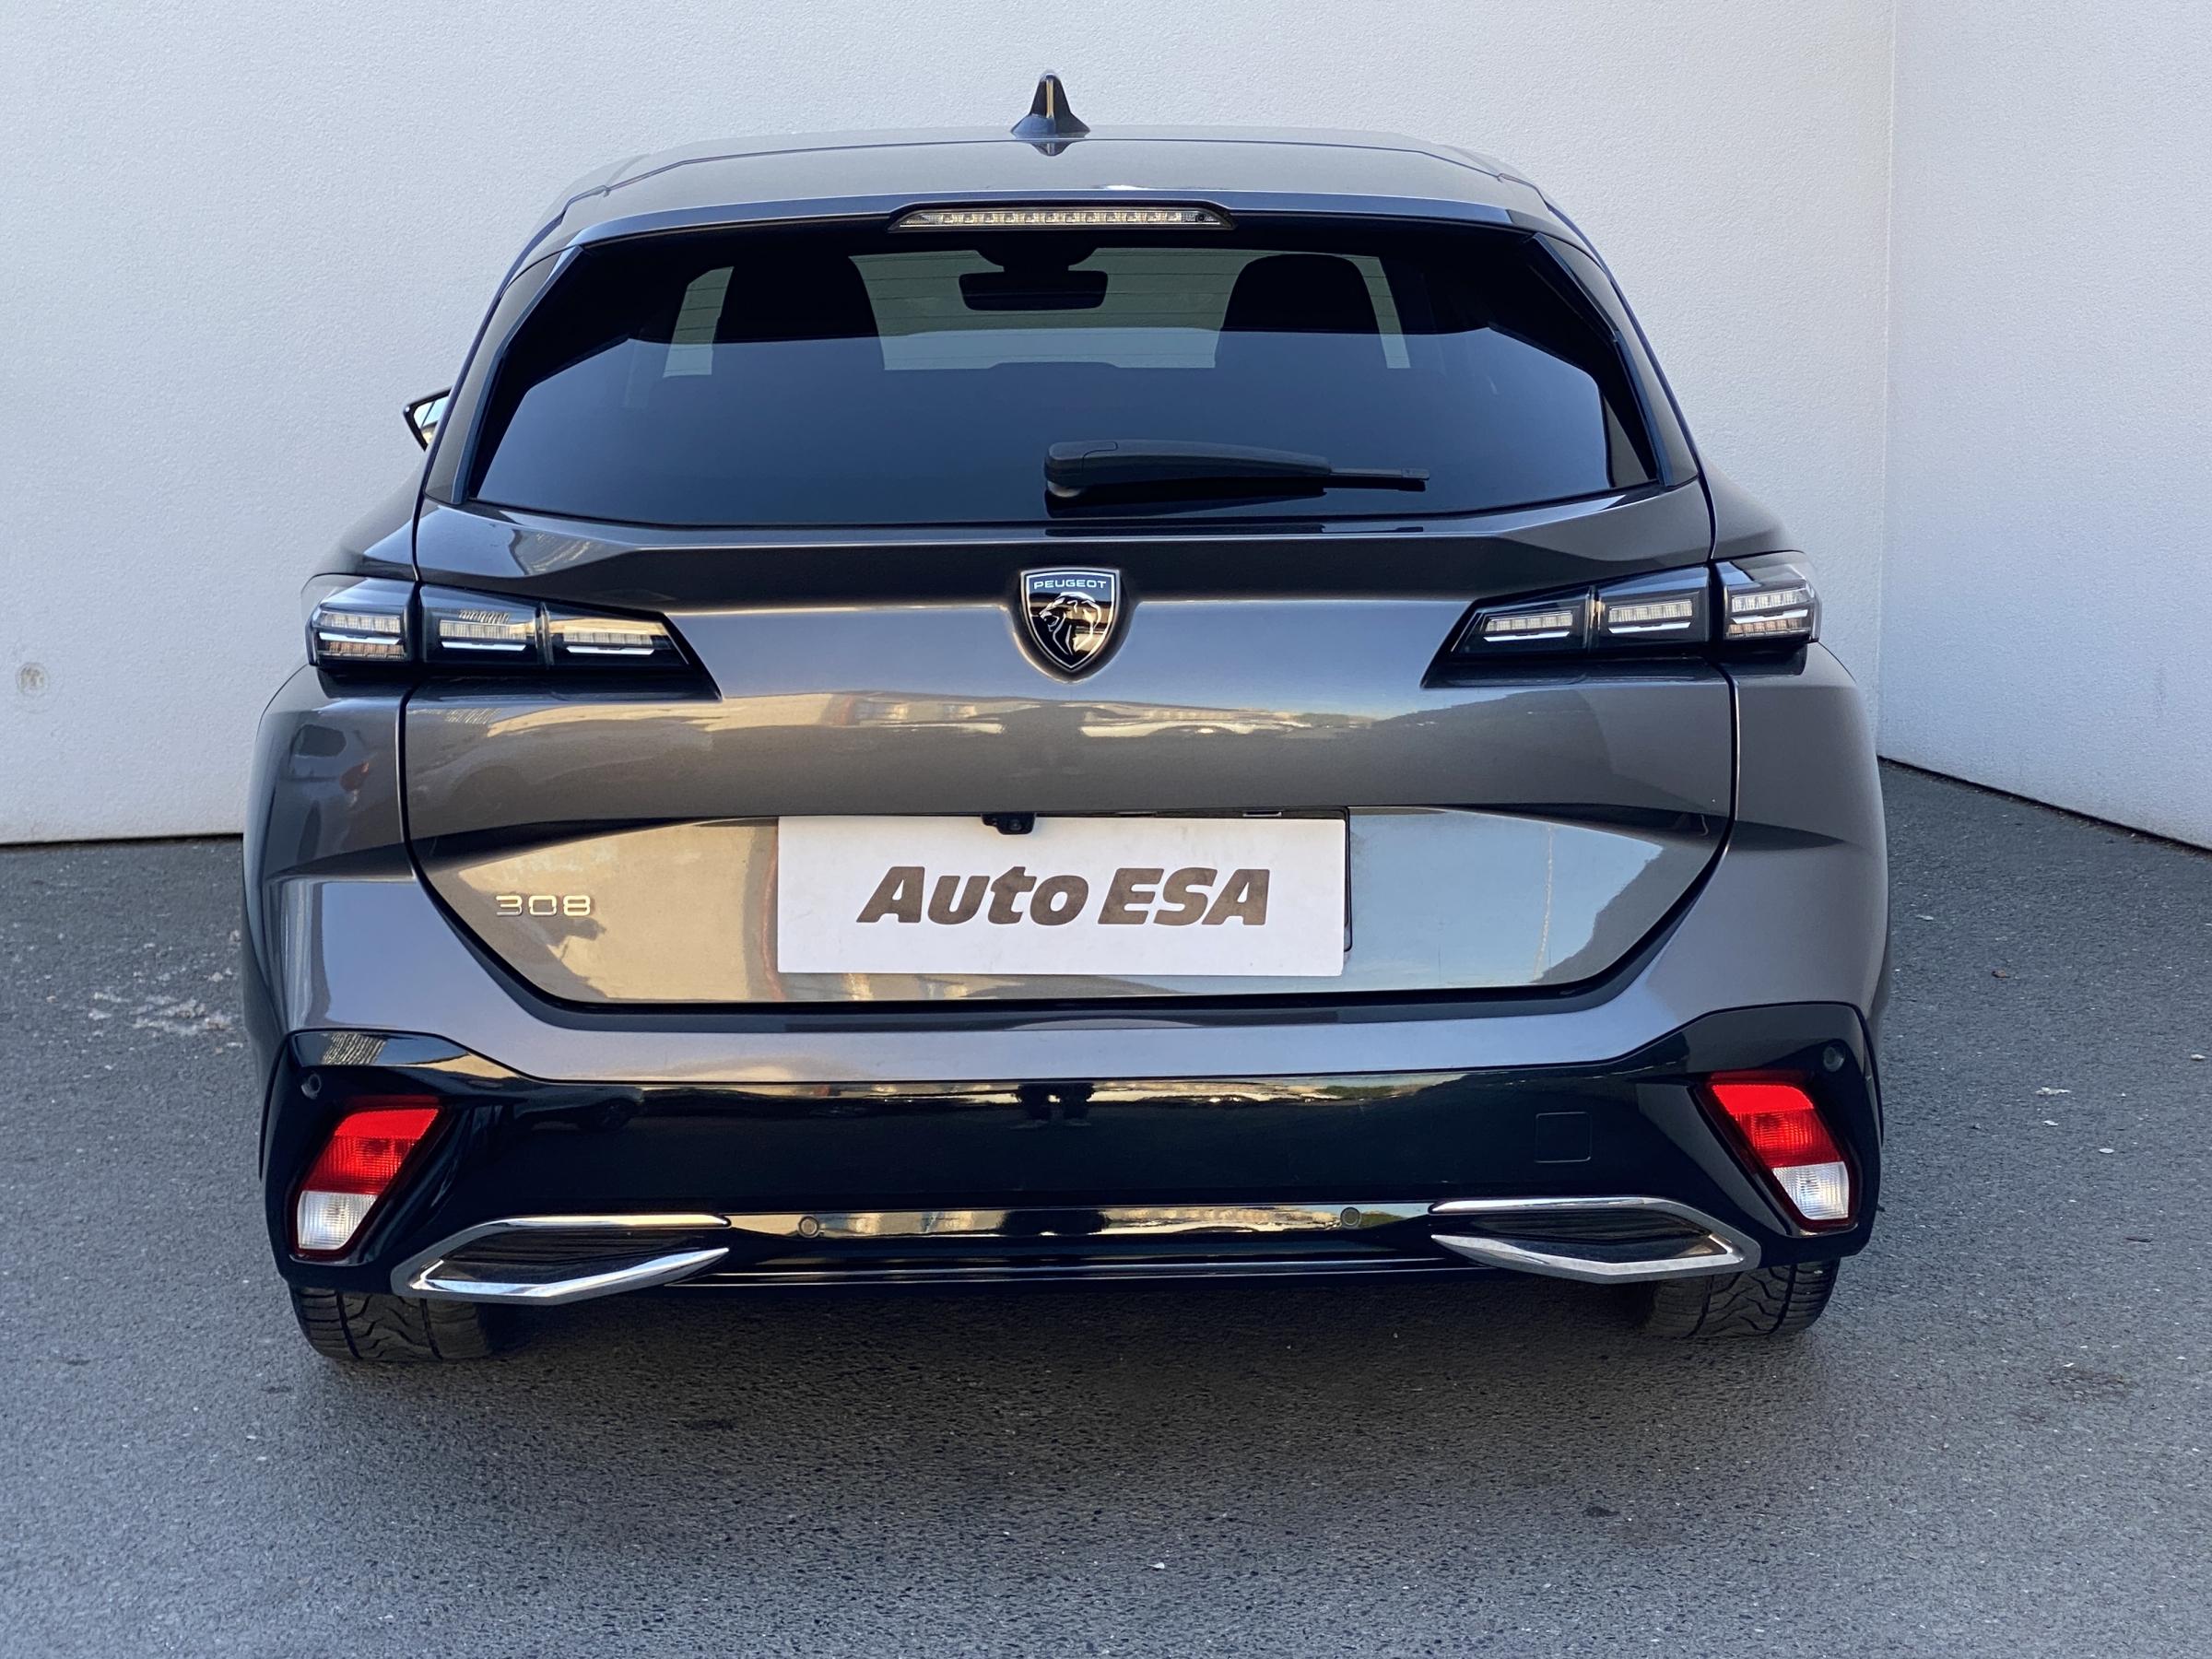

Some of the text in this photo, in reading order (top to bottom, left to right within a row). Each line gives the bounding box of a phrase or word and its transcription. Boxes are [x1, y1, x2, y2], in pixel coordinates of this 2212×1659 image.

[1034, 579, 1107, 589] PEUGEOT
[496, 895, 591, 916] 308
[856, 866, 1271, 925] Auto ESA
